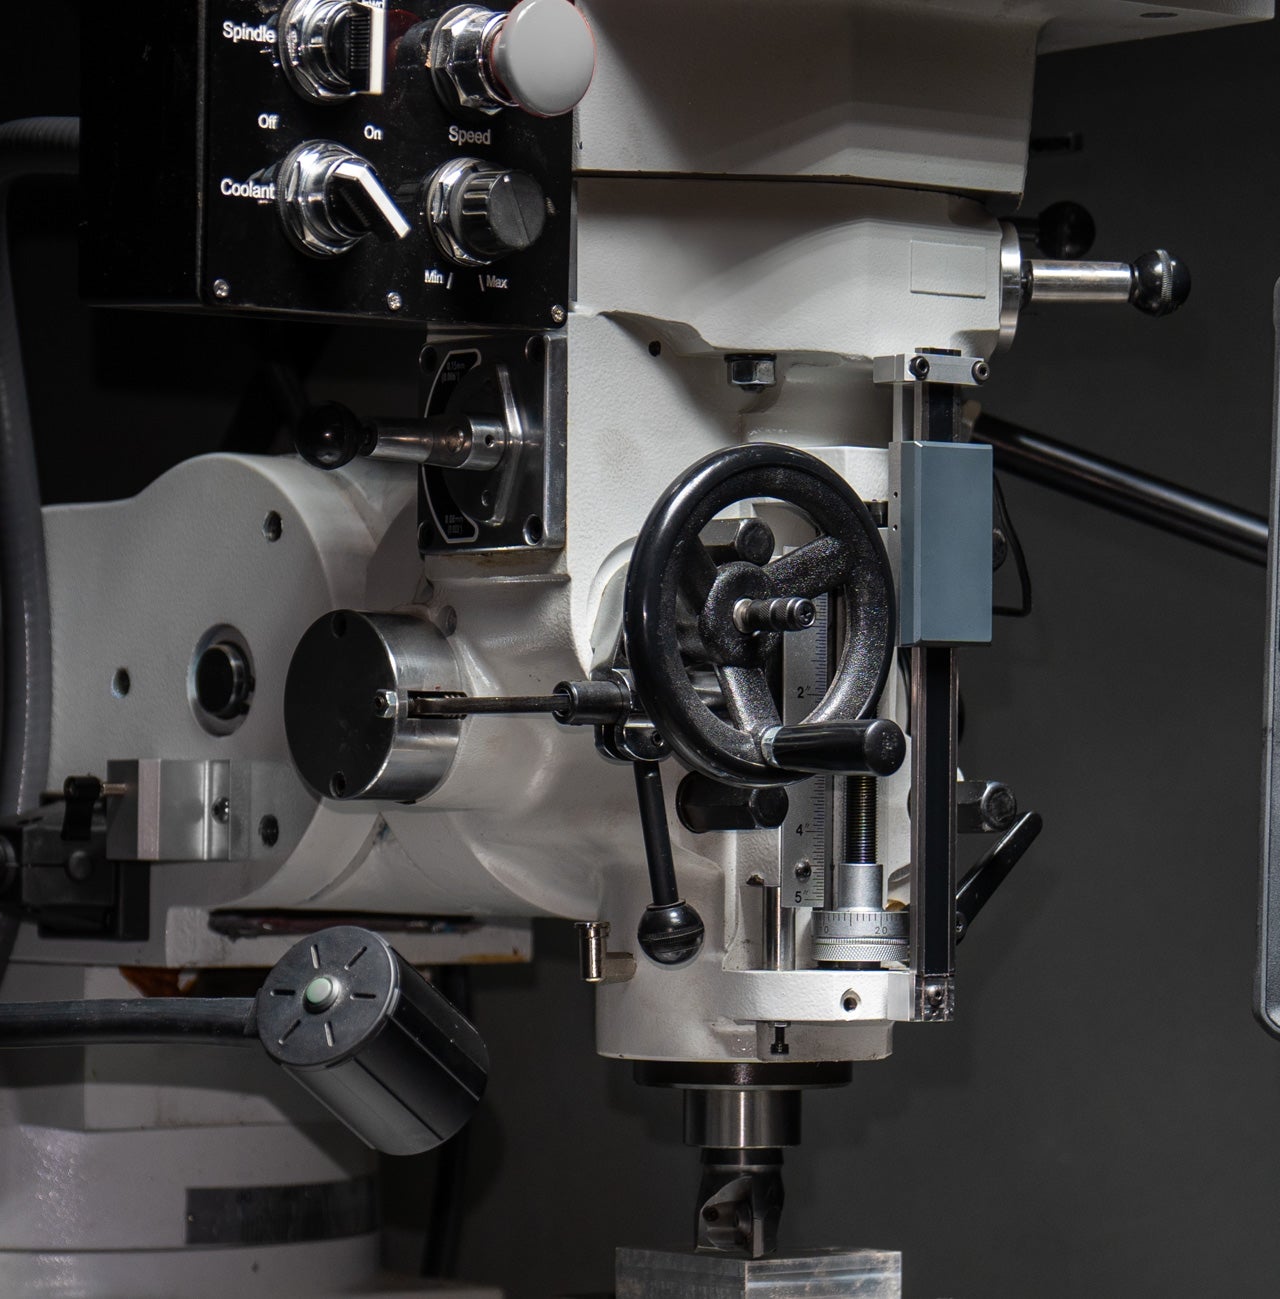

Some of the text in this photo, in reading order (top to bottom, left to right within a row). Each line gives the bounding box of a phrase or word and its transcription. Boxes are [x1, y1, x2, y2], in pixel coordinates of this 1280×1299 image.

[223, 21, 277, 43] Spindle
[257, 114, 279, 129] Off
[364, 125, 383, 140] On
[448, 125, 491, 146] Speed
[220, 178, 275, 199] Coolant
[424, 270, 443, 284] Min
[486, 275, 508, 289] Max
[875, 926, 888, 935] 20
